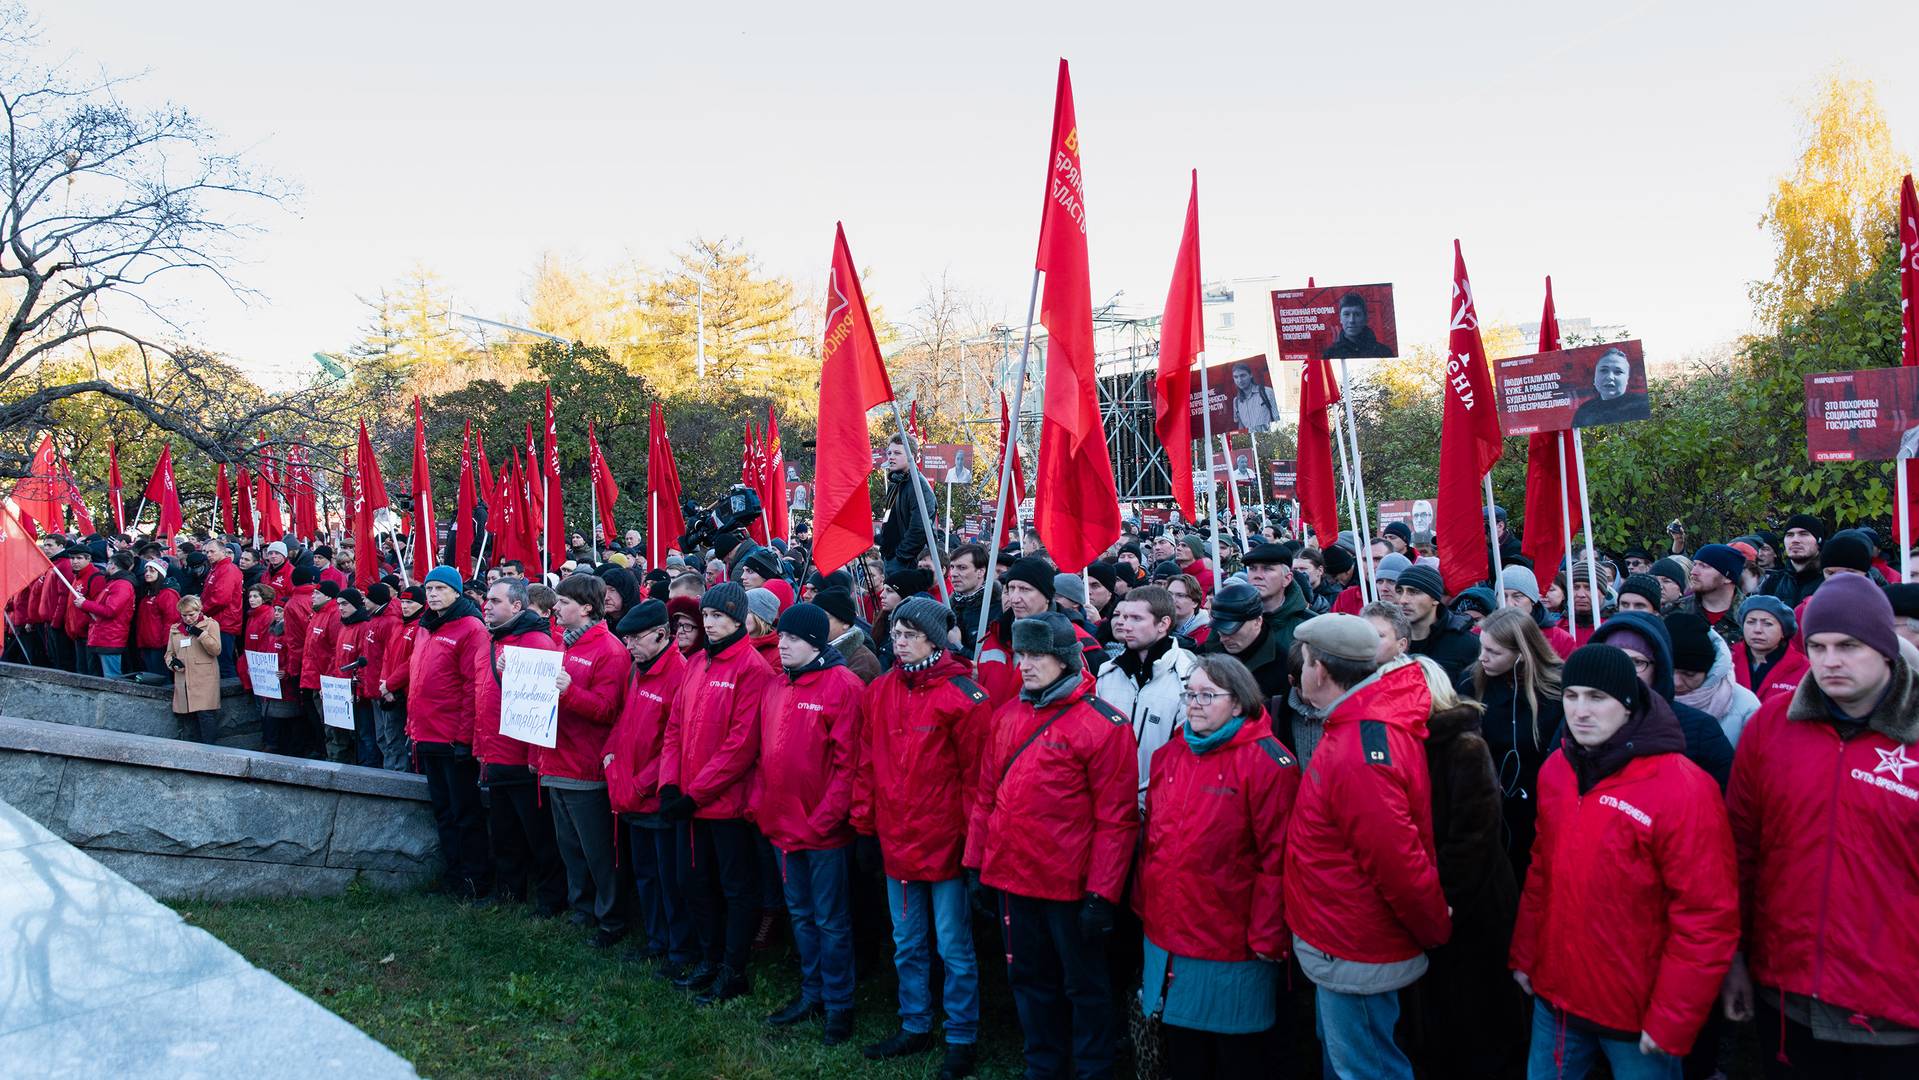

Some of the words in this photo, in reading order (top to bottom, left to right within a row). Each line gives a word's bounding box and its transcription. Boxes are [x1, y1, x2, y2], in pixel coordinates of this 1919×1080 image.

[1280, 308, 1311, 316] ПЕНСИОННАЯ
[1311, 306, 1335, 315] РЕФОРМА
[1281, 316, 1317, 324] ОКОНЧАТЕЛЬНО
[1281, 324, 1304, 332] ОФОРМИТ
[1305, 323, 1326, 331] РАЗРЫВ
[1504, 377, 1523, 387] ЛЮДИ
[1523, 375, 1543, 384] СТАЛИ
[1543, 372, 1561, 382] ЖИТЬ
[1524, 385, 1530, 393] А
[1530, 381, 1559, 392] РАБОТАТЬ
[1505, 395, 1527, 404] БУДЕМ
[1528, 391, 1553, 401] БОЛЬШЕ
[1507, 404, 1519, 413] ЭТО
[1825, 401, 1839, 410] ЭТО
[1839, 399, 1879, 409] ПОХОРОНЫ
[1825, 409, 1877, 420] СОЦИАЛЬНОГО
[1825, 419, 1877, 430] ГОСУДАРСТВА
[1851, 768, 1875, 784] СУТЬ
[1875, 776, 1919, 801] ВРЕМЕНИ
[1599, 795, 1618, 808] СУТЬ
[1618, 800, 1652, 827] ВРЕМЕНИ
